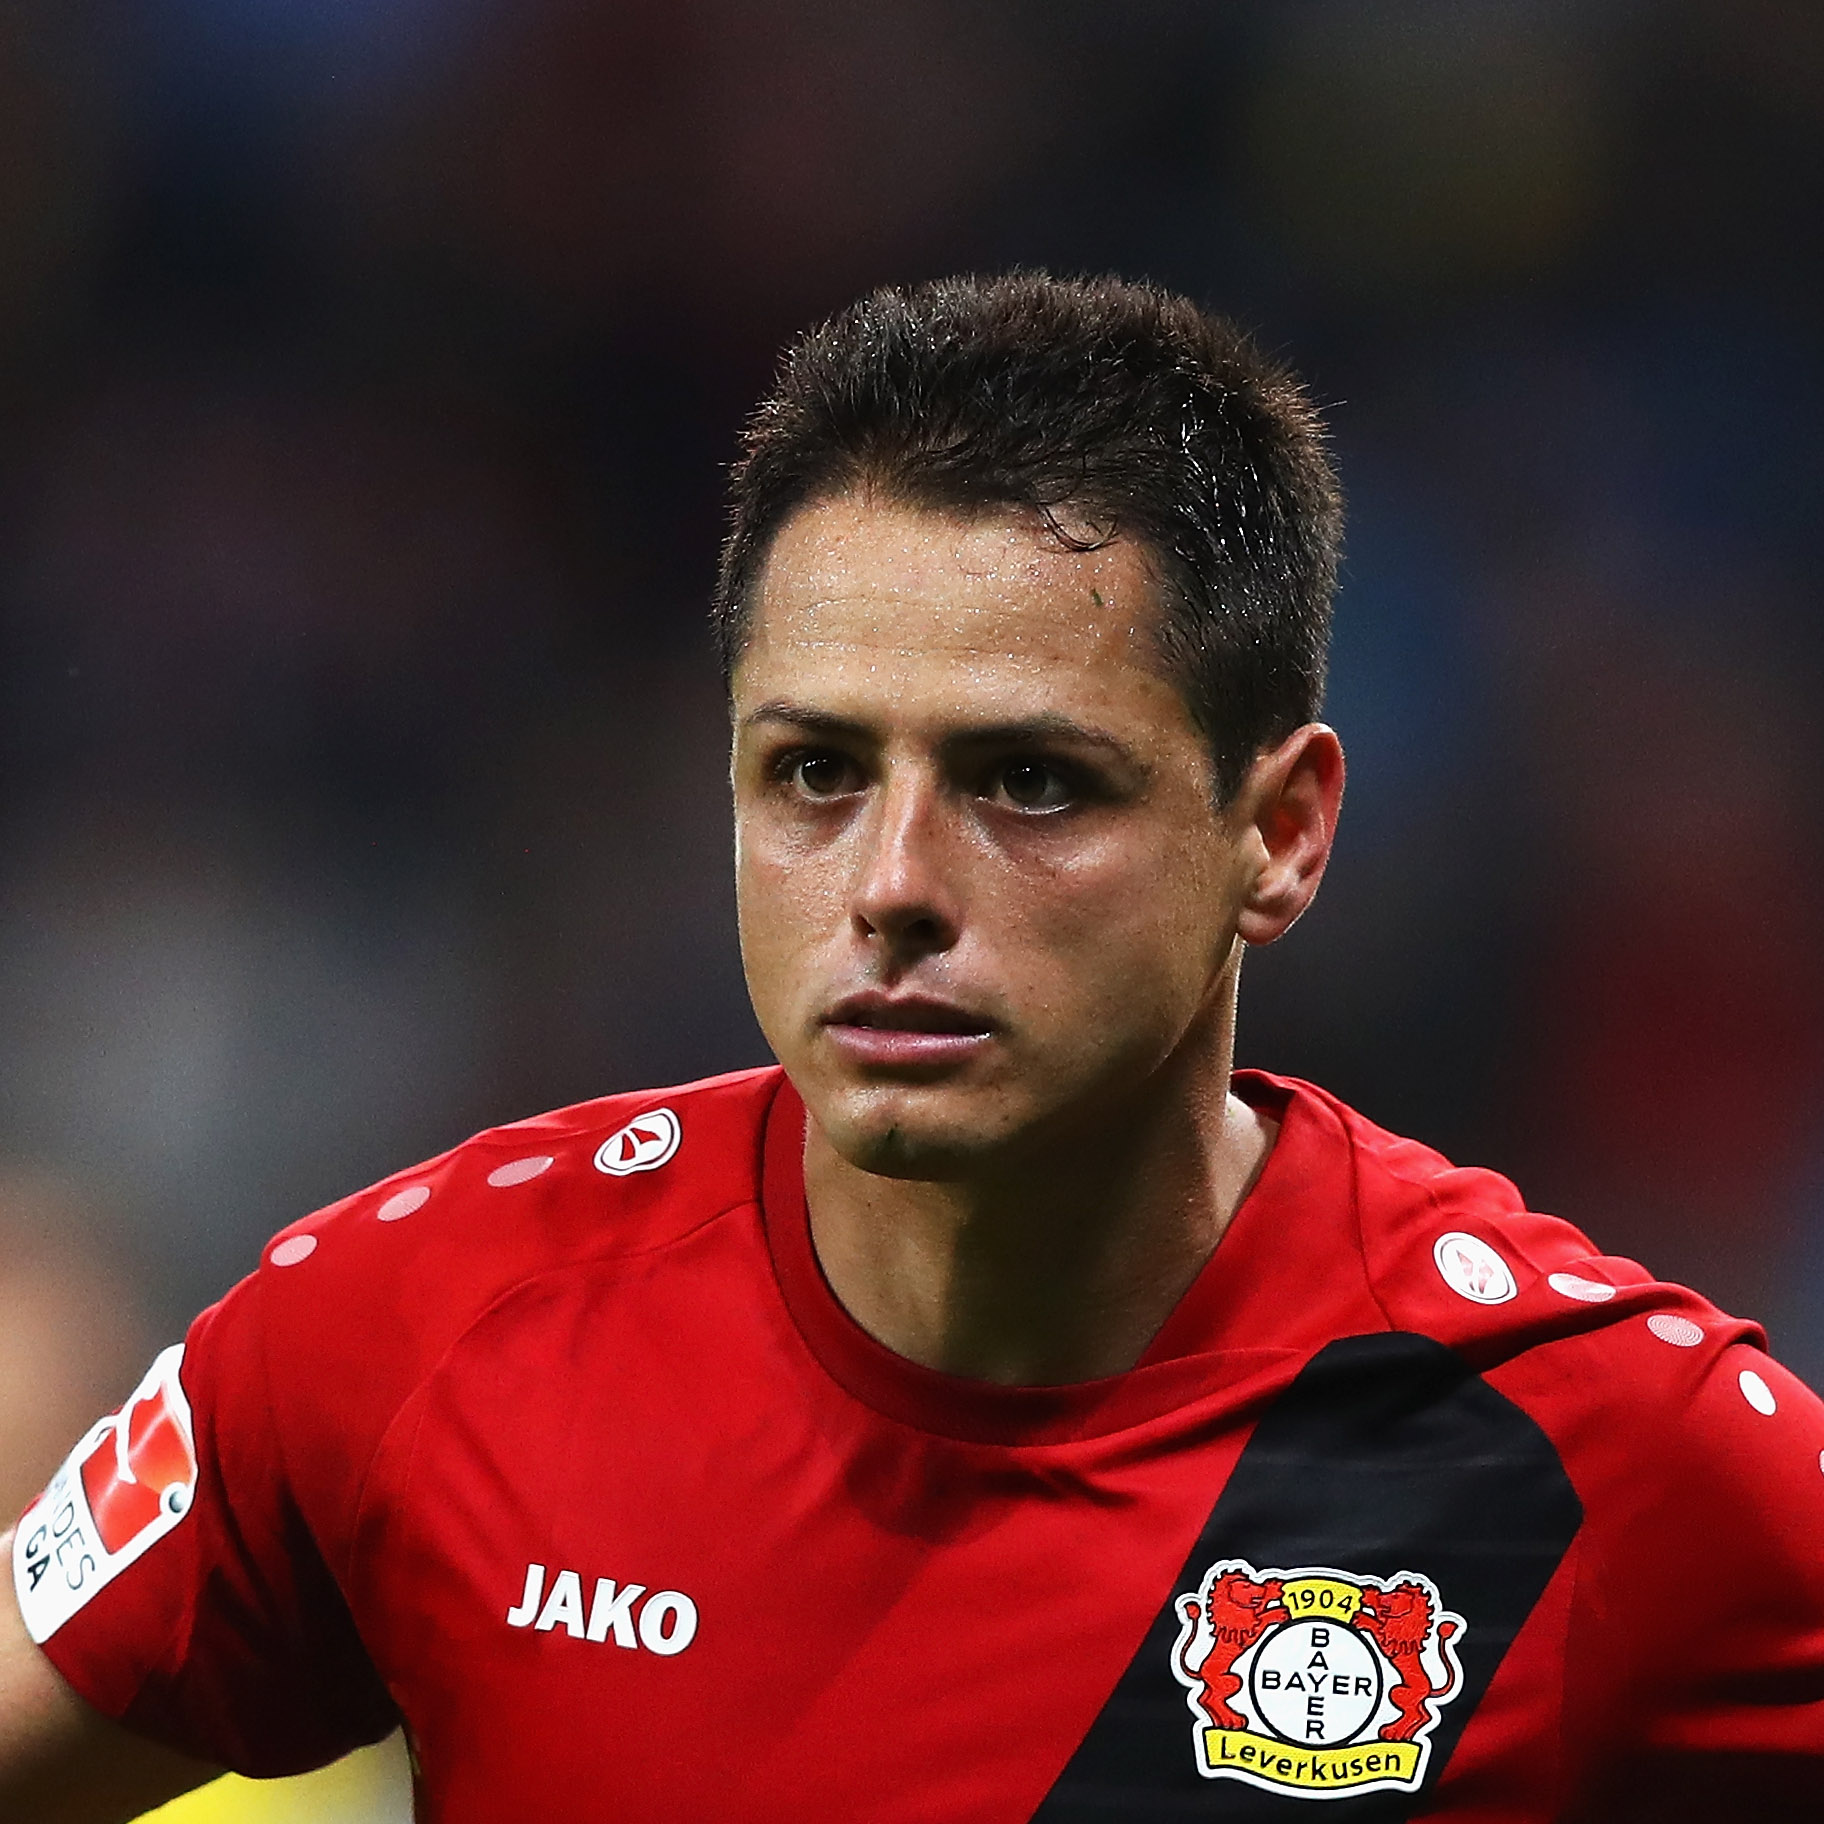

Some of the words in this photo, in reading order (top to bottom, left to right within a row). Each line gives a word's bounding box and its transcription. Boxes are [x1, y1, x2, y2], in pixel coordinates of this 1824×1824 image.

[507, 1563, 698, 1656] JAKO
[1287, 1588, 1354, 1615] 1904
[1261, 1669, 1373, 1698] BAYER
[1306, 1627, 1330, 1740] BAYER
[1219, 1735, 1402, 1782] Leverkusen
